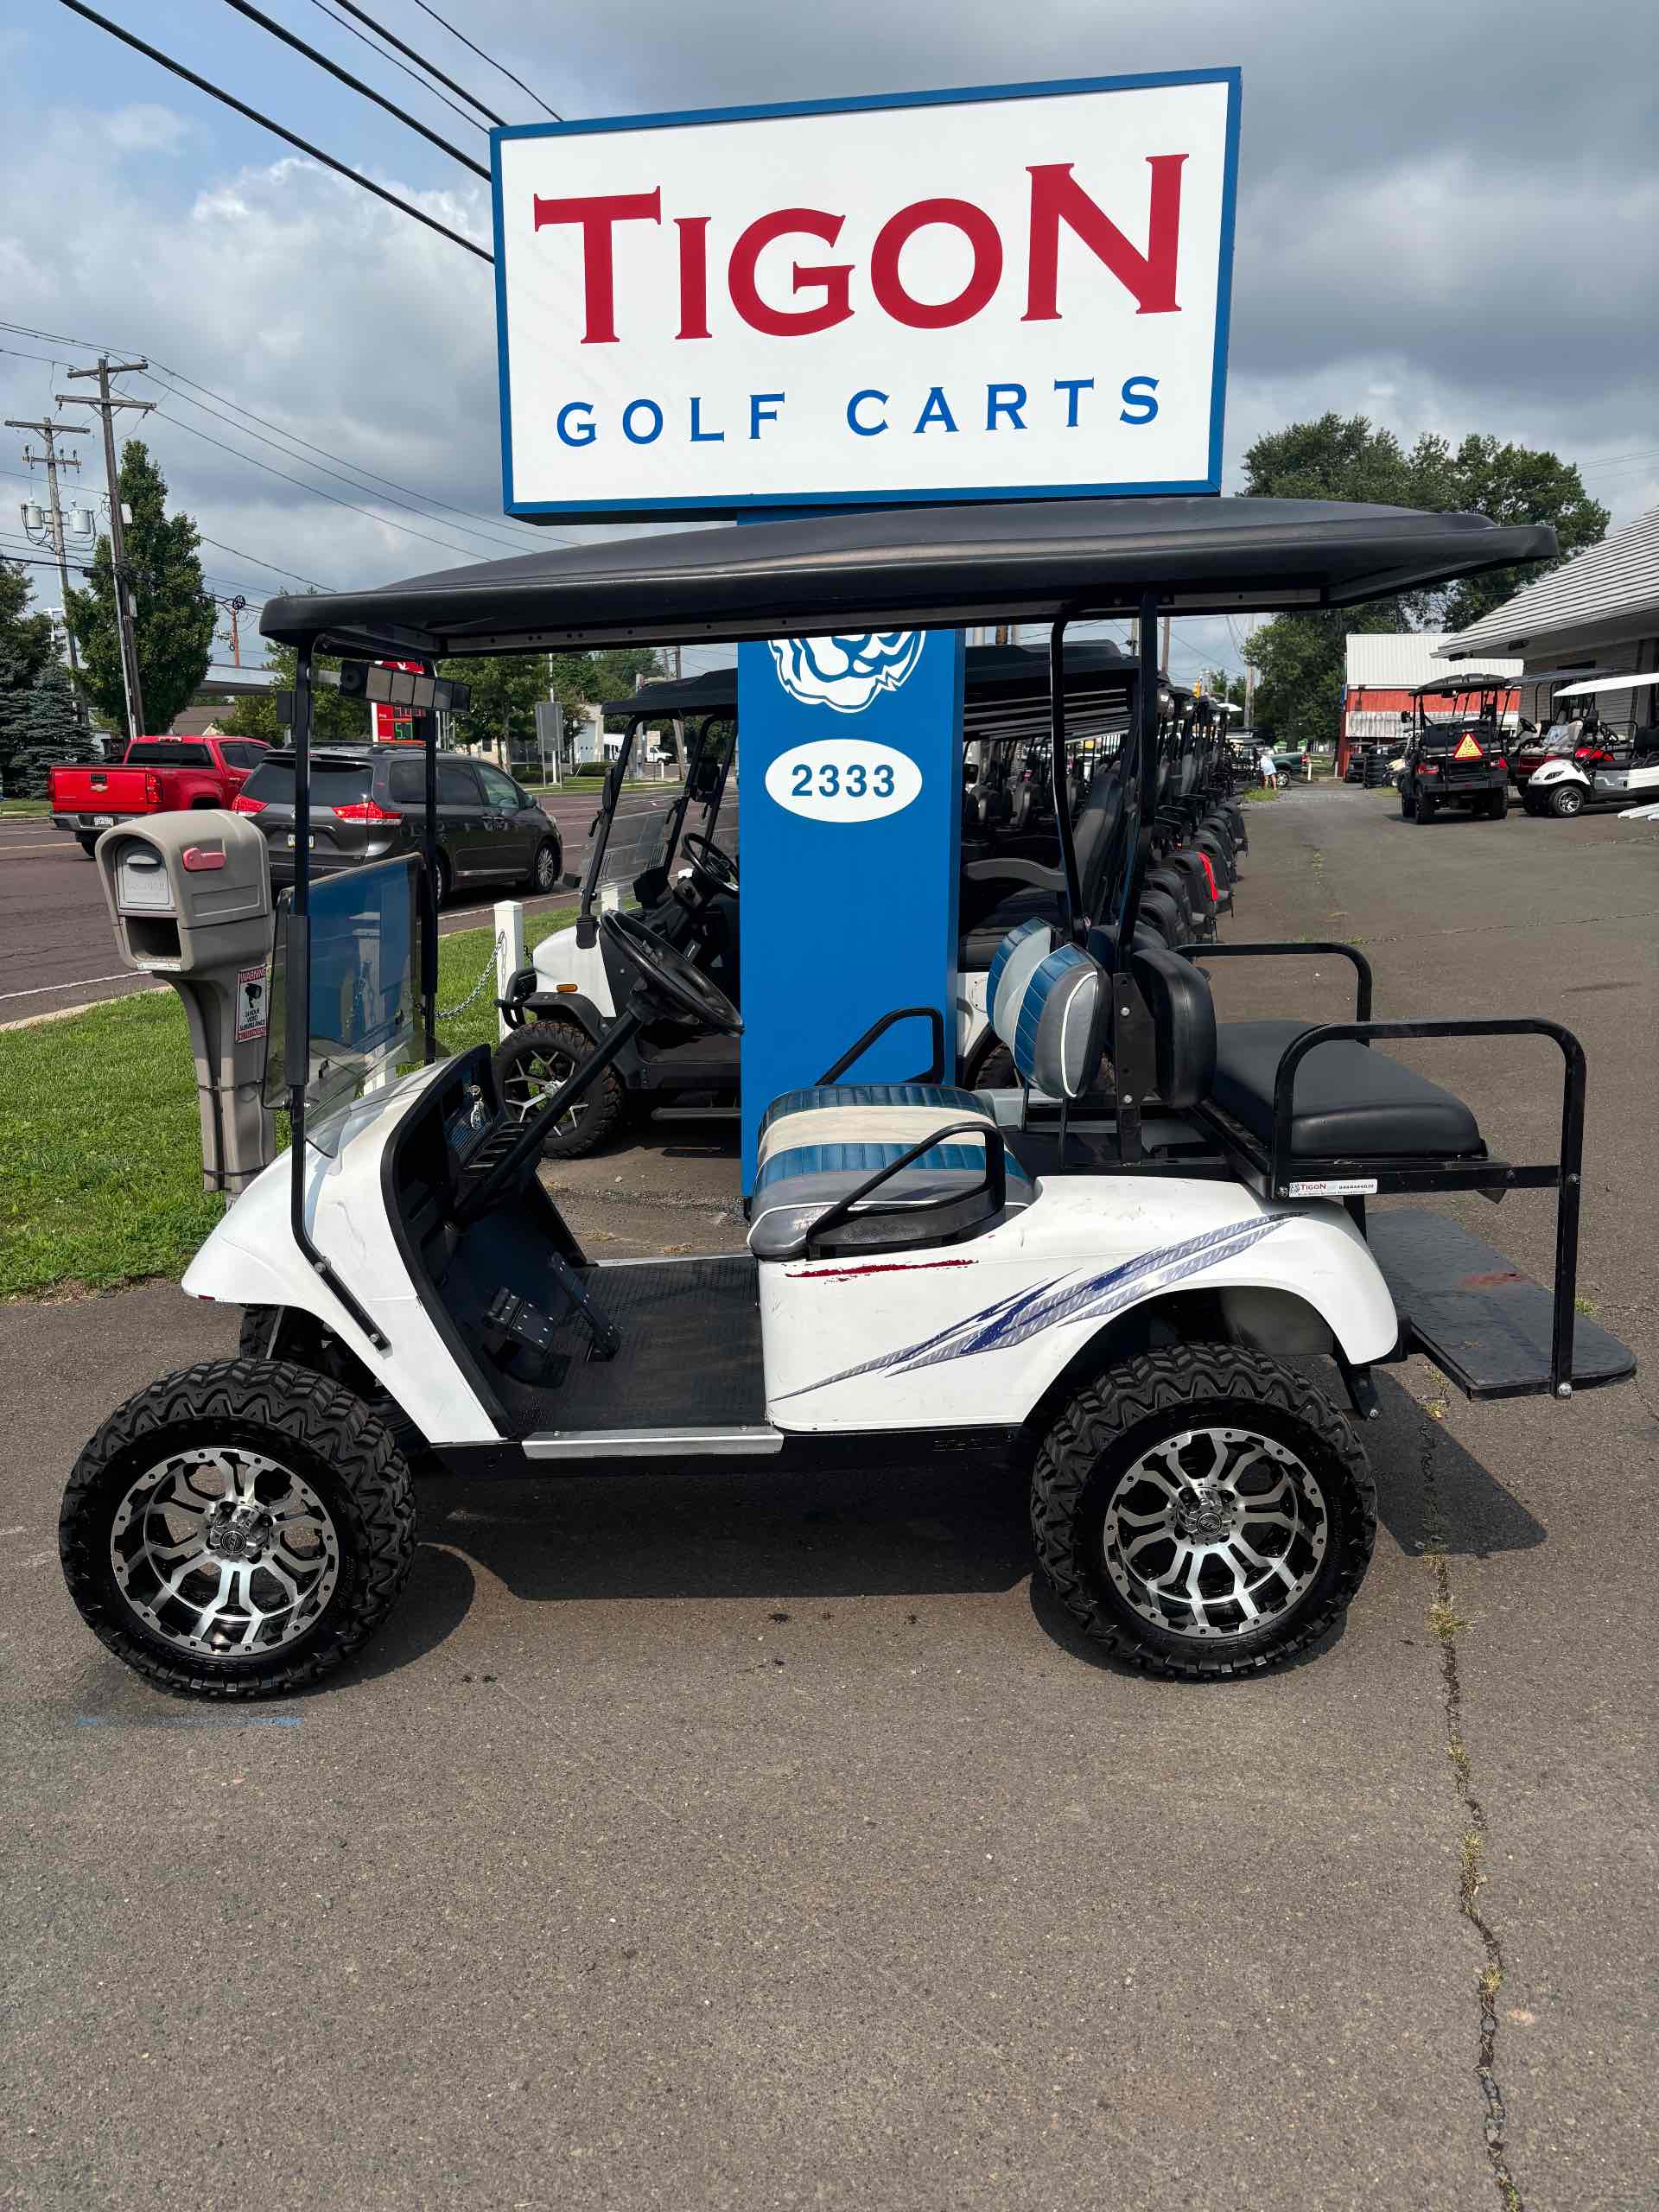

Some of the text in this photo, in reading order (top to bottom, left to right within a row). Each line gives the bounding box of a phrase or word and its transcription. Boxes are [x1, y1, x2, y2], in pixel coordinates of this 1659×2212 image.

[534, 154, 1189, 343] TIGON
[556, 376, 1160, 448] GOLF CARTS
[791, 764, 895, 798] 2333
